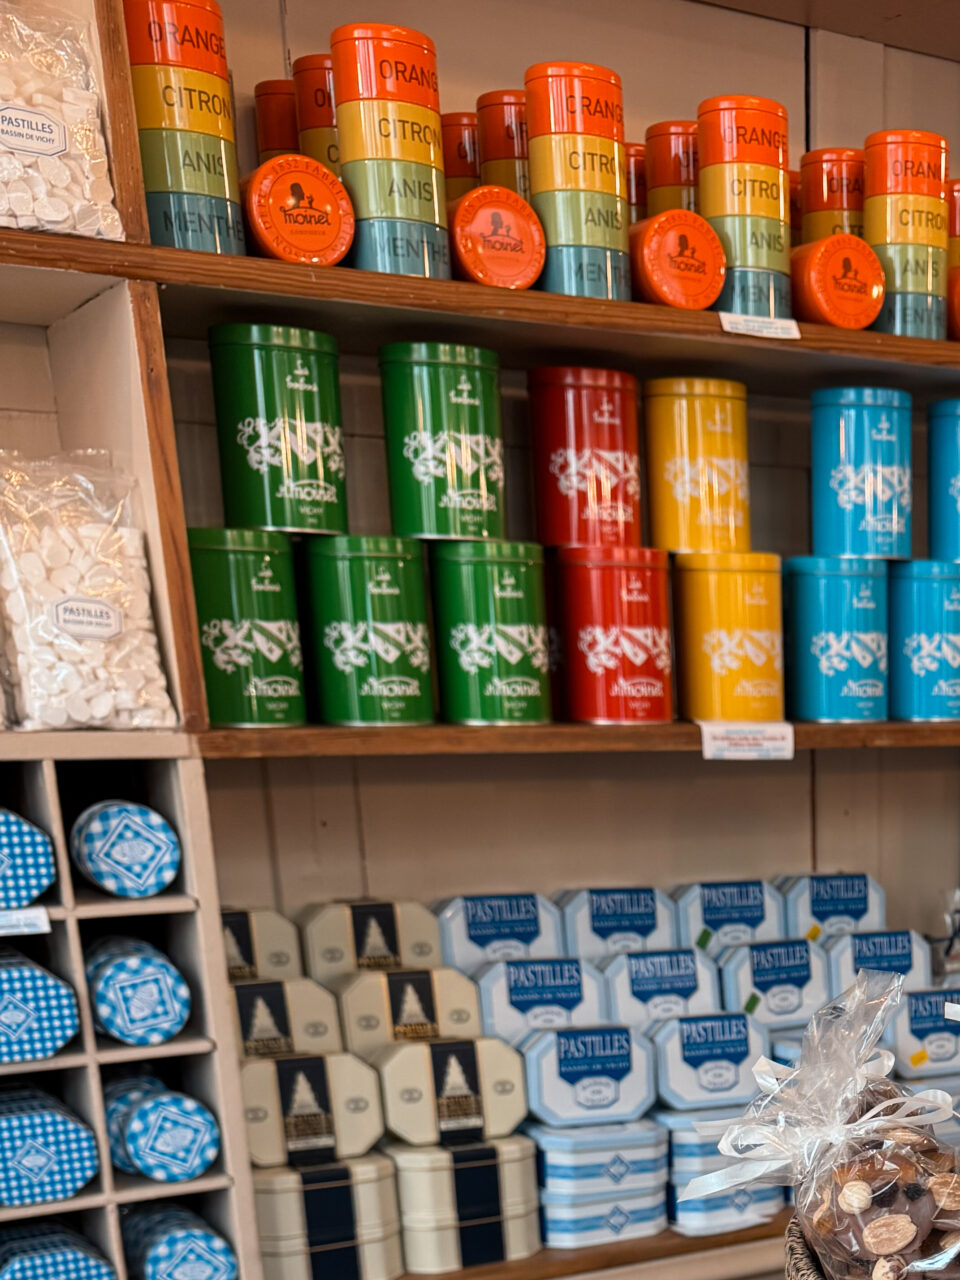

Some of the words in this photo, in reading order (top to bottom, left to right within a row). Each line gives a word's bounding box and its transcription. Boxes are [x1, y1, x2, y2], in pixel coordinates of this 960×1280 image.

[148, 20, 226, 59] ORANGE
[162, 85, 231, 120] CITRON
[1, 115, 53, 134] PASTILLES
[26, 133, 33, 141] DE
[35, 135, 54, 144] VICHY
[388, 177, 432, 202] ANIS
[164, 210, 243, 244] MENTHE
[585, 206, 622, 231] ANIS
[750, 232, 783, 253] ANIS
[63, 606, 111, 621] PASTILLES
[703, 884, 763, 907] PASTILLES
[811, 878, 867, 899] PASTILLES
[467, 899, 537, 923] PASTILLES
[592, 894, 656, 916] PASTILLES
[752, 946, 809, 969] PASTILLES
[854, 936, 911, 957] PASTILLES
[510, 964, 581, 987] PASTILLES
[631, 957, 696, 979] PASTILLES
[683, 1020, 748, 1044] PASTILLES
[560, 1034, 630, 1059] PASTILLES
